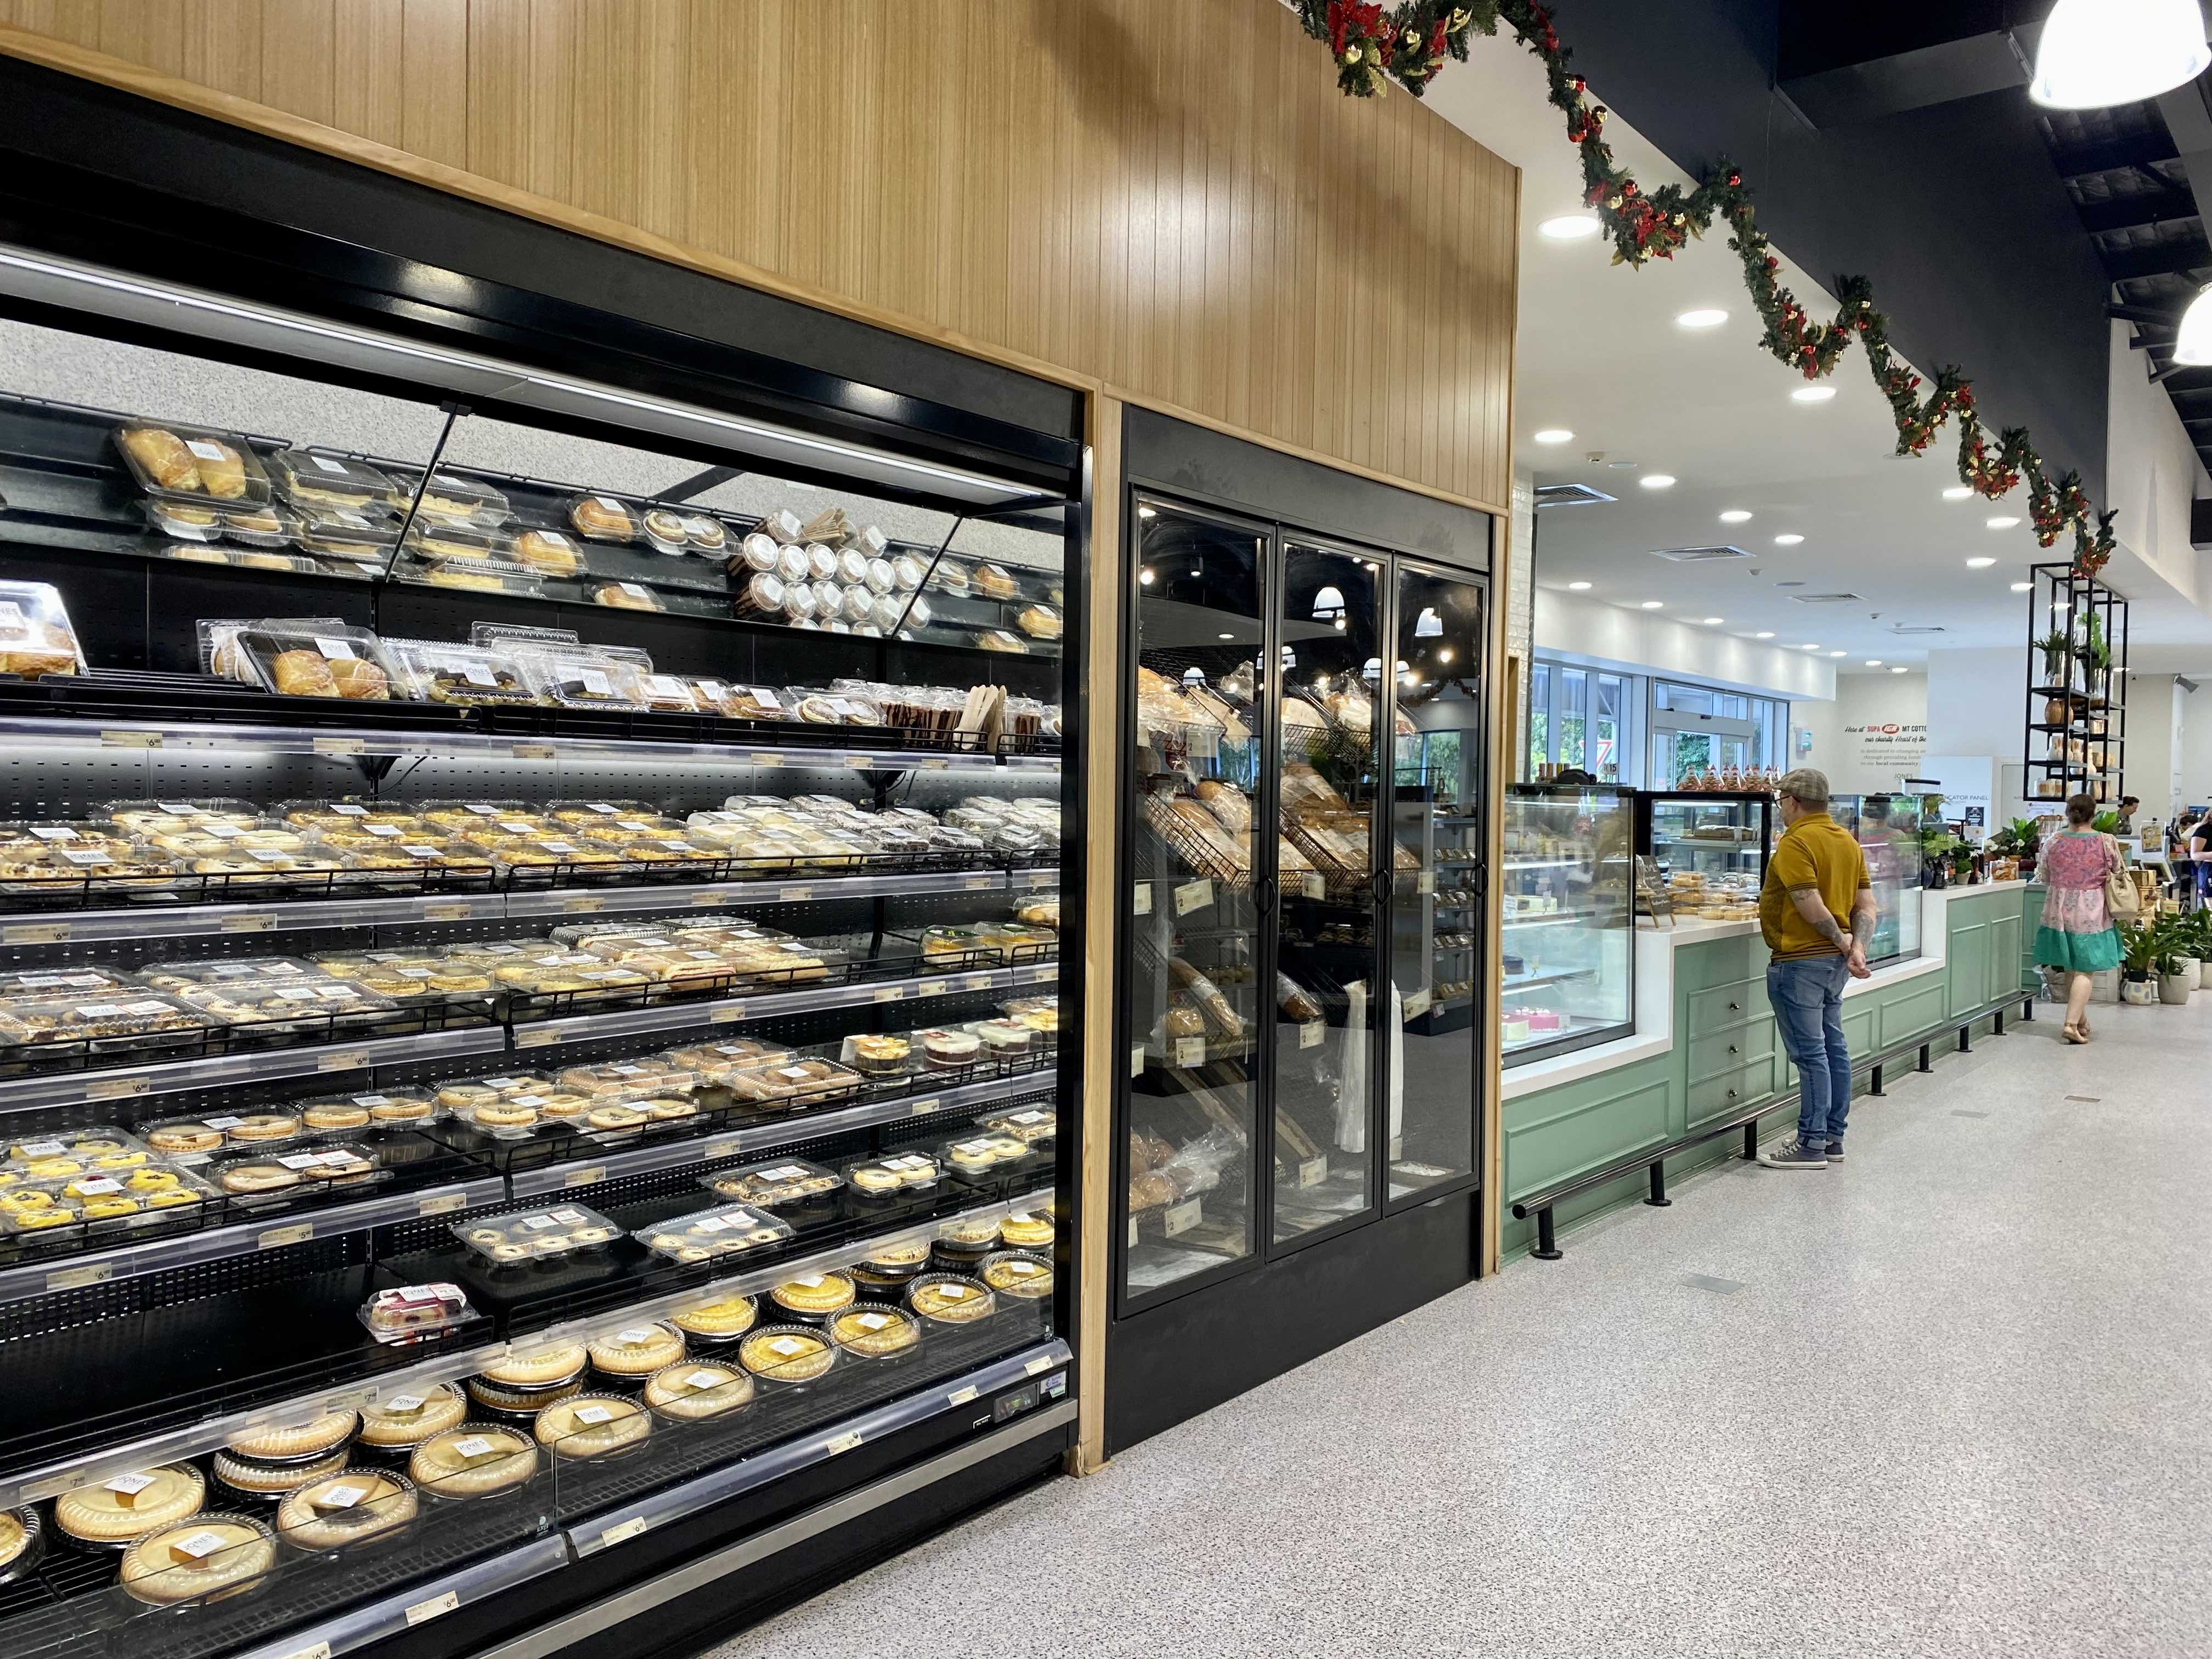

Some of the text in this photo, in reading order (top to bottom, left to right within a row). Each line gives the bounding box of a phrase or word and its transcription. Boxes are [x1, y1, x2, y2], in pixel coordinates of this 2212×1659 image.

[321, 642, 349, 651] JONES
[466, 667, 490, 676] JONES
[584, 674, 606, 684] JONES
[27, 1143, 60, 1152] JONES
[285, 1156, 311, 1164] JONES
[81, 1182, 117, 1190] JONES
[580, 1409, 605, 1418] JONES
[459, 1440, 486, 1451] JONES
[119, 1475, 149, 1487] JONES
[330, 1487, 350, 1504] JONES
[185, 1534, 213, 1551] JONES
